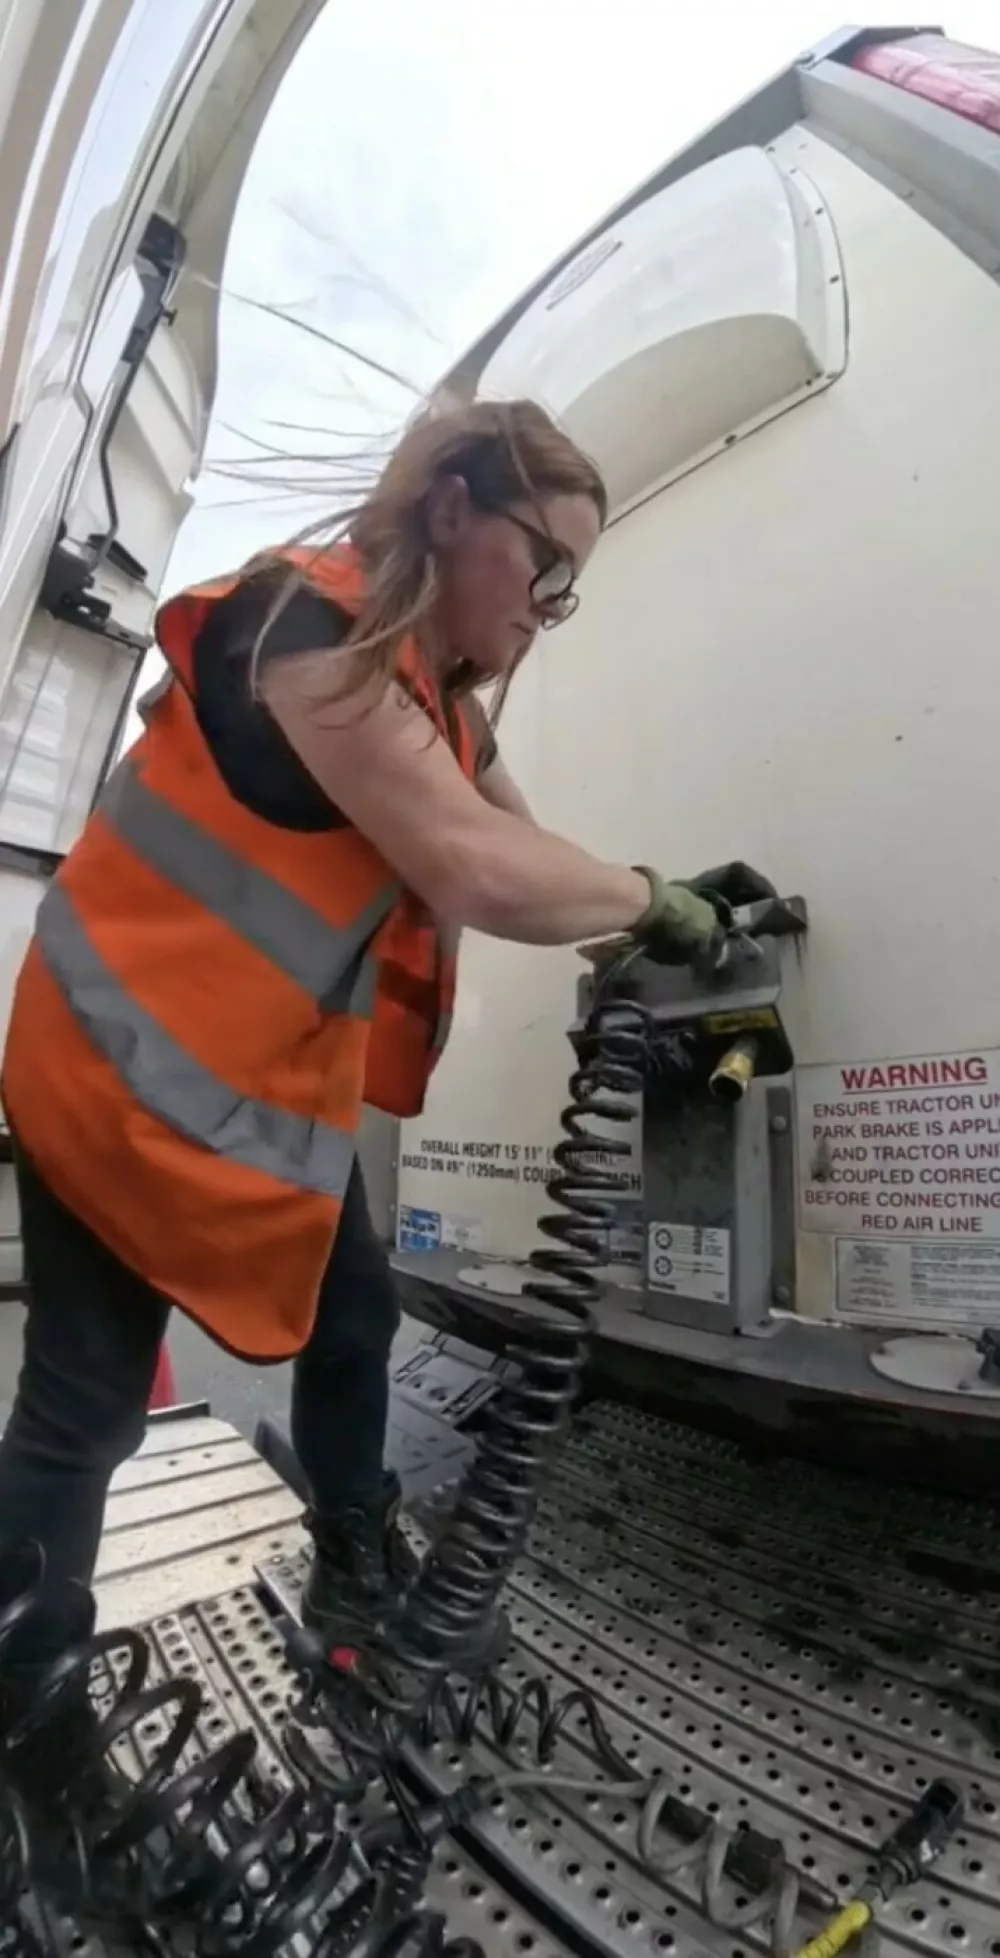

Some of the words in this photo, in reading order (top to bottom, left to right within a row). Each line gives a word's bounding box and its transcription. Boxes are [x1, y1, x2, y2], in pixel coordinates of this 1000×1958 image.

[841, 1057, 988, 1090] WARNING
[813, 1101, 881, 1118] ENSURE
[885, 1095, 974, 1115] TRACTOR
[813, 1124, 856, 1140] PARK
[861, 1122, 920, 1139] BRAKE
[925, 1121, 943, 1136] IS
[462, 1142, 501, 1158] HEIGHT
[831, 1146, 868, 1162] AND
[872, 1144, 959, 1161] TRACTOR
[829, 1168, 915, 1184] COUPLED
[805, 1190, 871, 1206] BEFORE
[876, 1191, 1000, 1208] CONNECTING
[862, 1214, 898, 1230] RED
[903, 1216, 933, 1231] AIR
[940, 1217, 983, 1232] LINE
